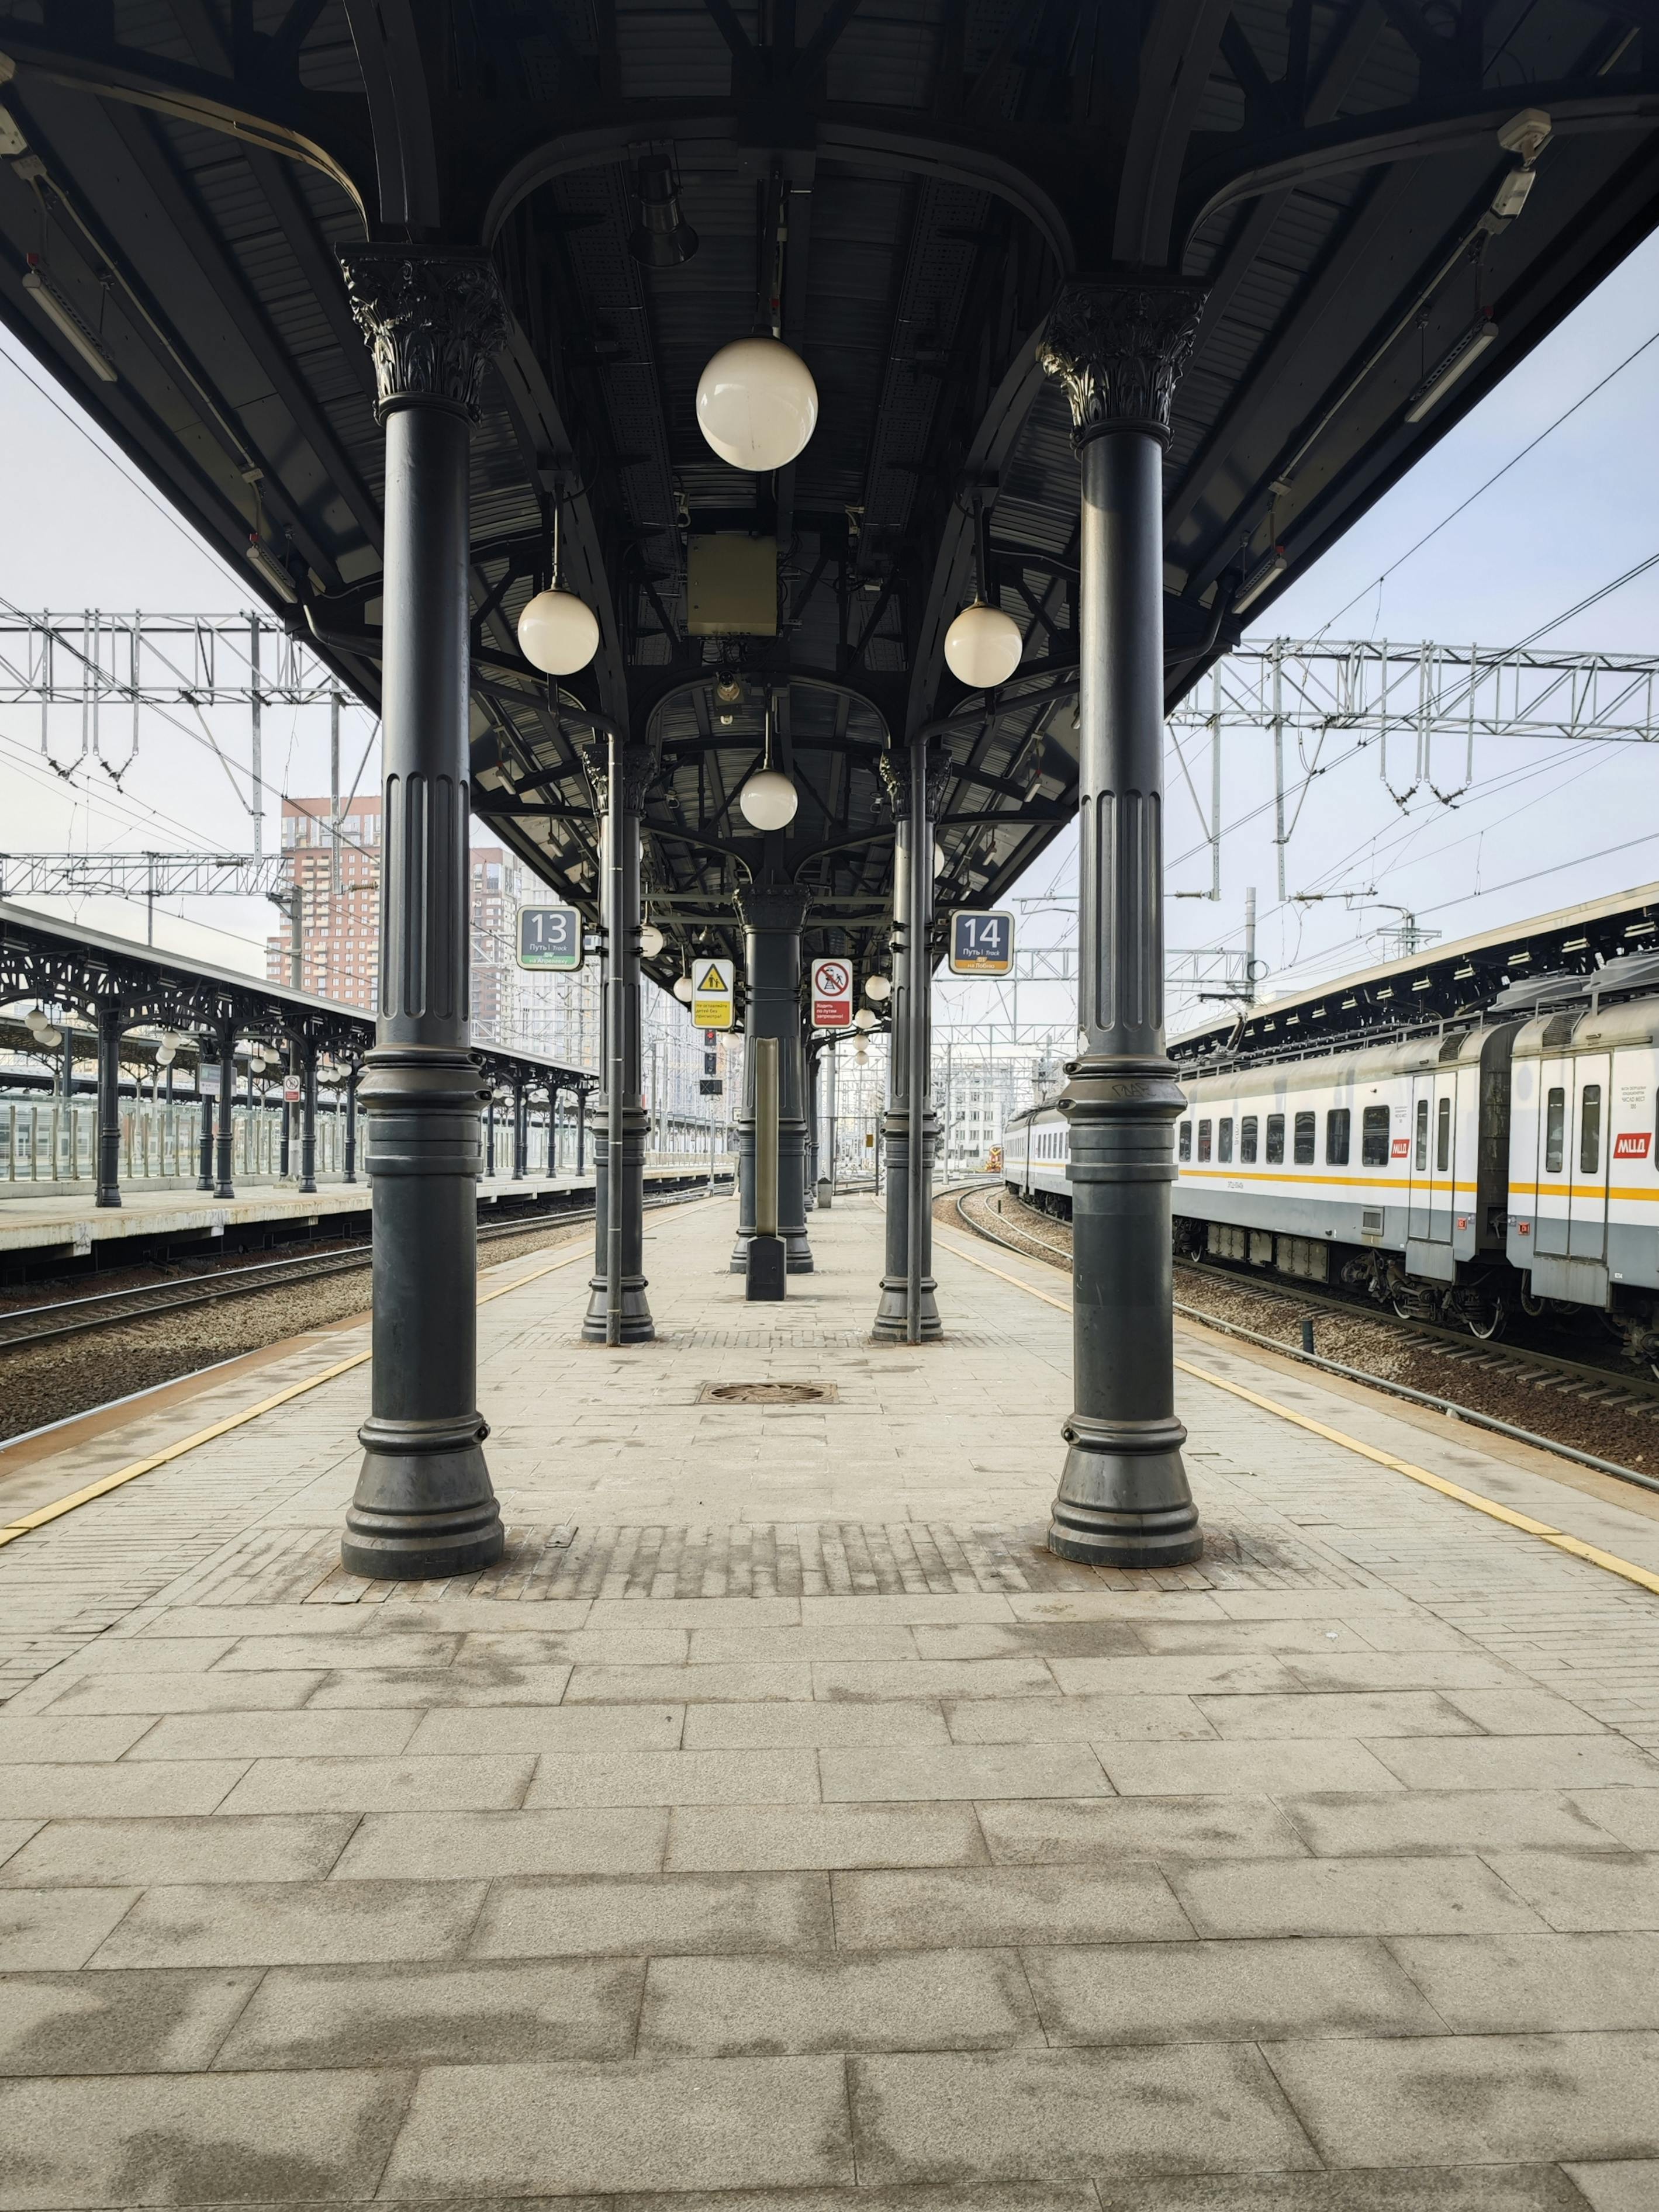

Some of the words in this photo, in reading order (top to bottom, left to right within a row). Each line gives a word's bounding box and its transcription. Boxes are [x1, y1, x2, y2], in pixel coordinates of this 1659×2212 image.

[531, 913, 566, 943] 13
[964, 918, 1001, 948] 14
[530, 943, 547, 952] Путь
[963, 948, 980, 957] Путь
[1393, 1143, 1407, 1154] МЦД
[1617, 1138, 1646, 1154] МЦД
